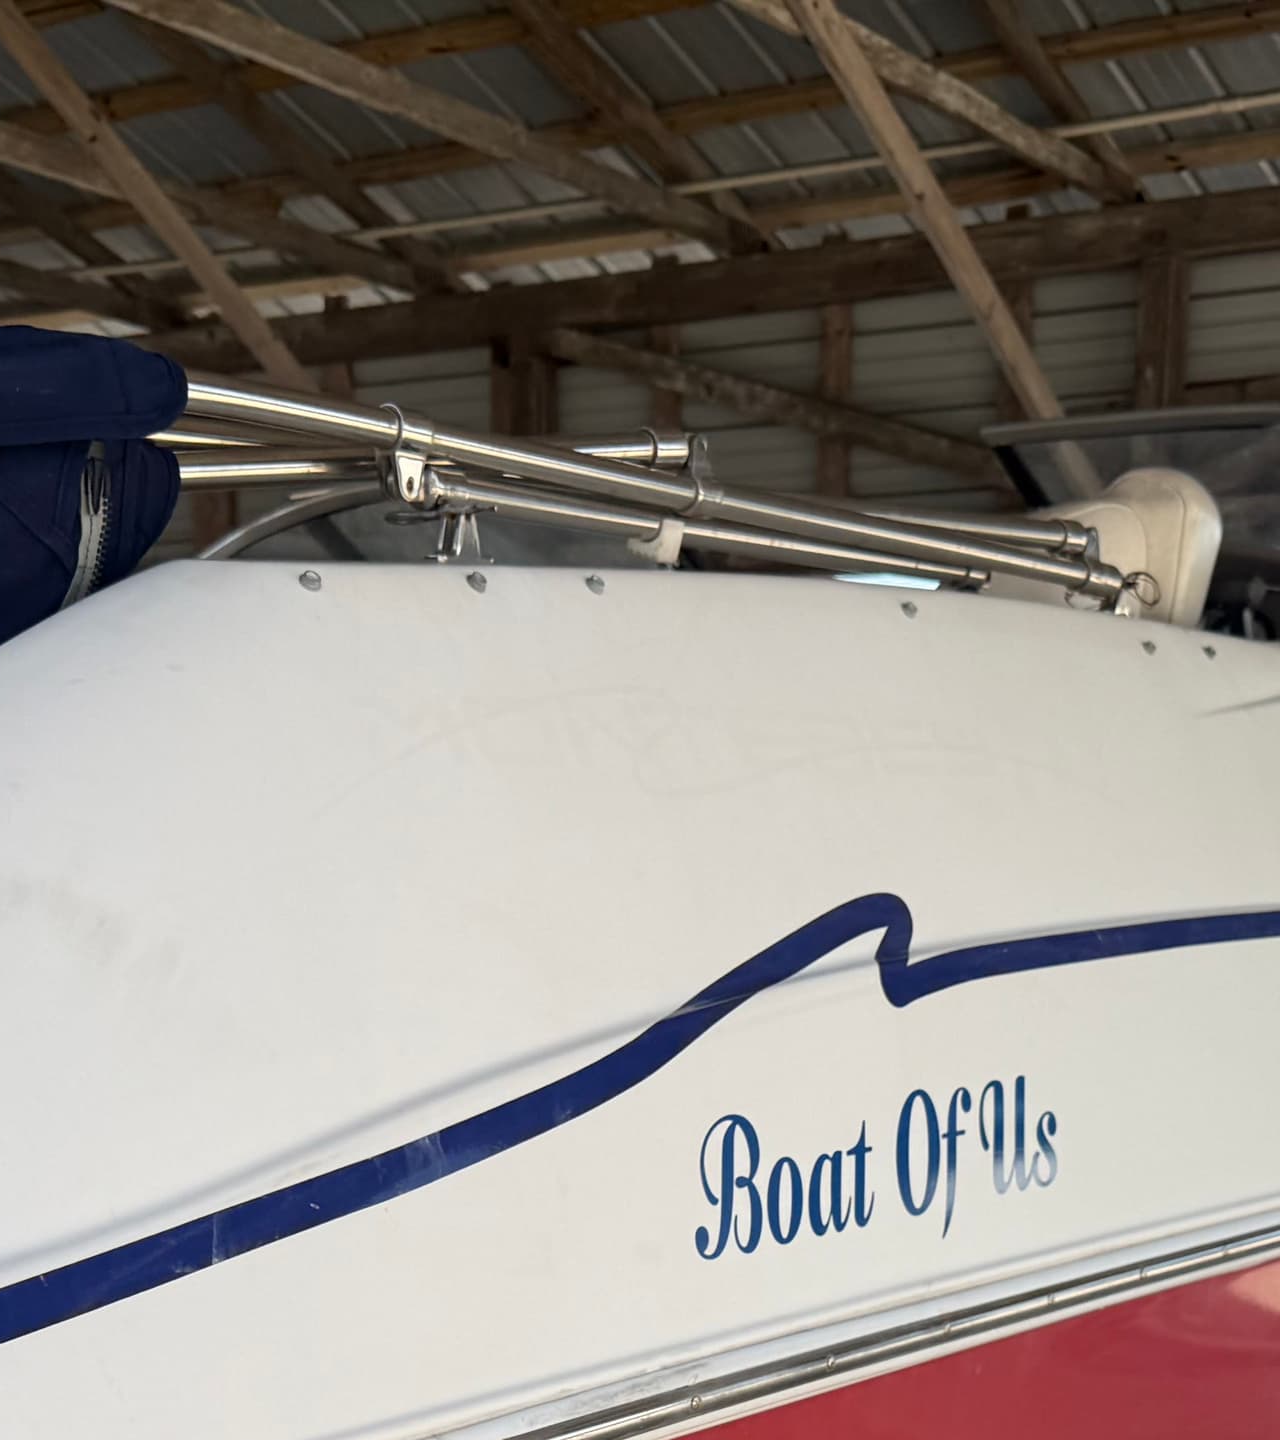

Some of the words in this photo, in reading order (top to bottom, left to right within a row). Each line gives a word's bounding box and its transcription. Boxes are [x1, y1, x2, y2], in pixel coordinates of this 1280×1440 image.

[694, 1113, 875, 1260] Boat
[895, 1086, 972, 1240] Of
[978, 1074, 1059, 1195] Us
